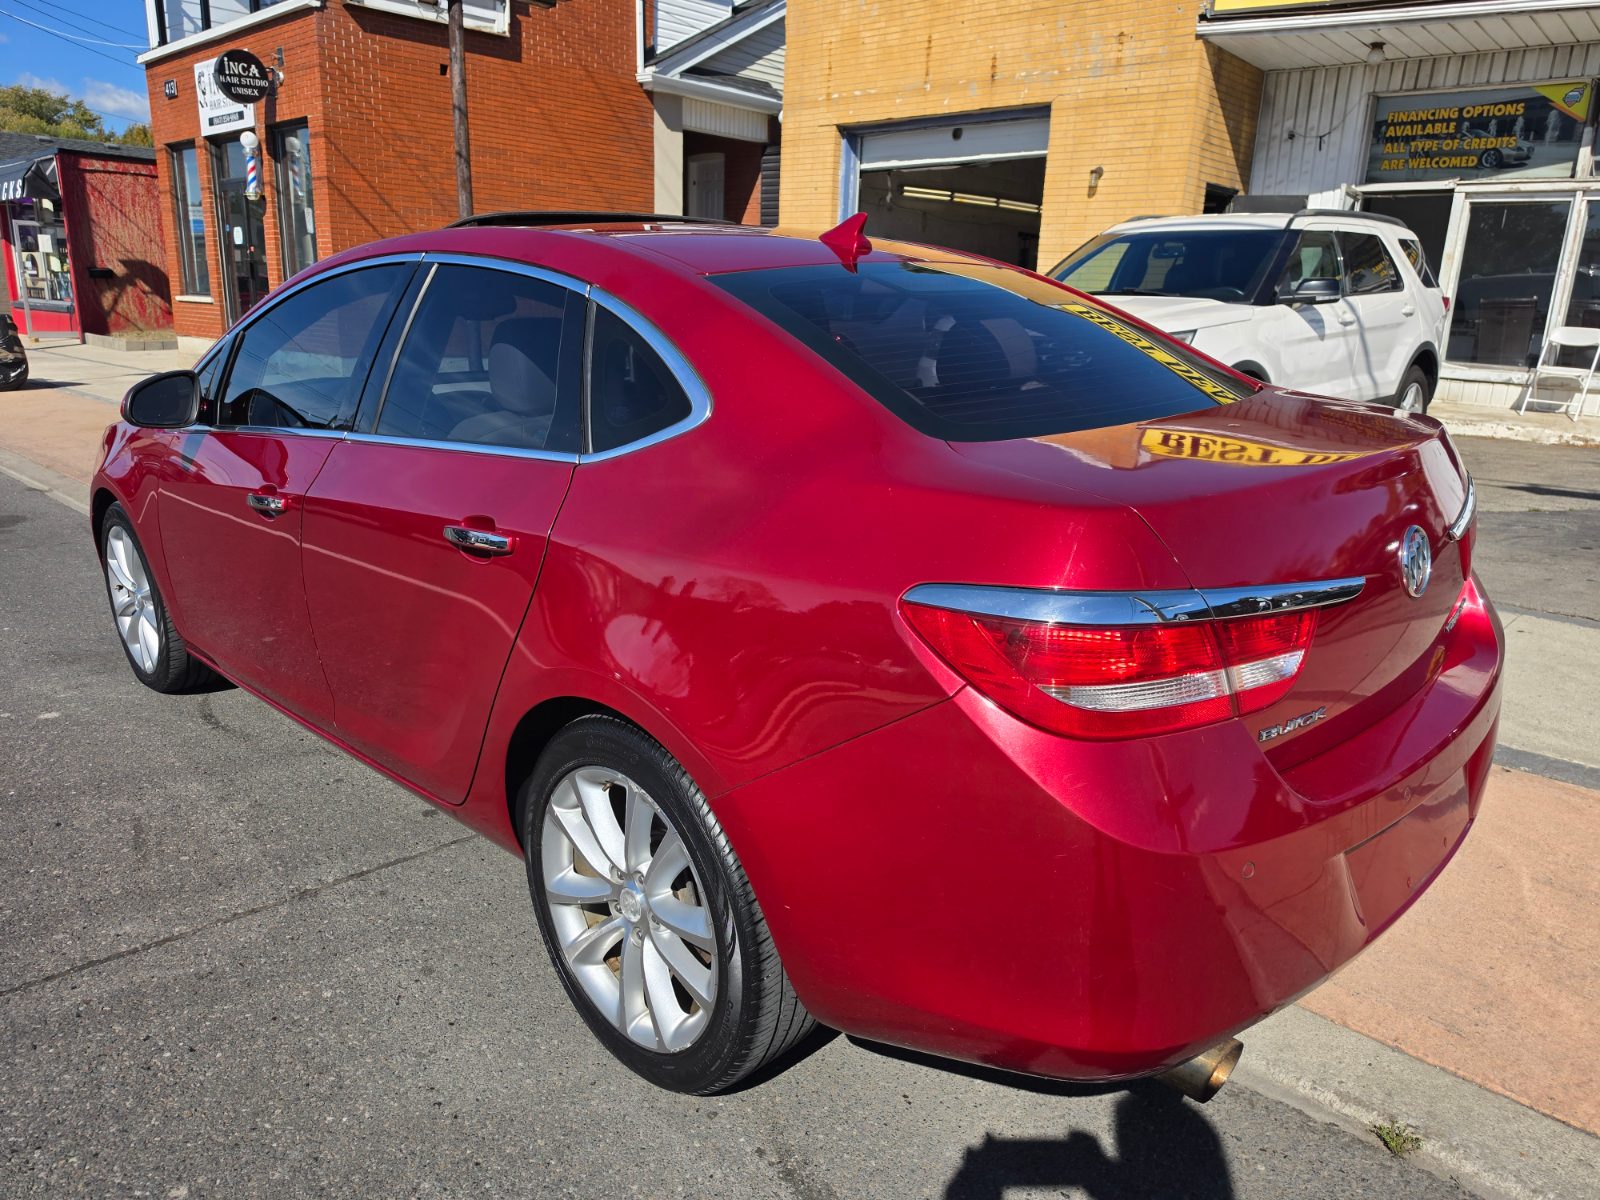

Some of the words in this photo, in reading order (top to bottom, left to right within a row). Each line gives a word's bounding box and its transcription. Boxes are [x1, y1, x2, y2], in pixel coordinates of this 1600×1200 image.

[220, 75, 240, 85] HAIR
[241, 77, 269, 87] STUDIO
[231, 86, 259, 96] UNISEX
[1387, 107, 1459, 123] FINANCING
[1462, 103, 1525, 118] OPTIONS
[1385, 122, 1457, 137] AVAILABLE
[1383, 142, 1407, 154] ALL
[1410, 140, 1439, 153] TYPE
[1442, 139, 1460, 151] OF
[1463, 136, 1517, 150] CREDITS
[1381, 159, 1406, 170] ARE
[1408, 155, 1478, 169] WELCOMED
[0, 179, 22, 200] CKS
[1258, 706, 1327, 741] BUICK
